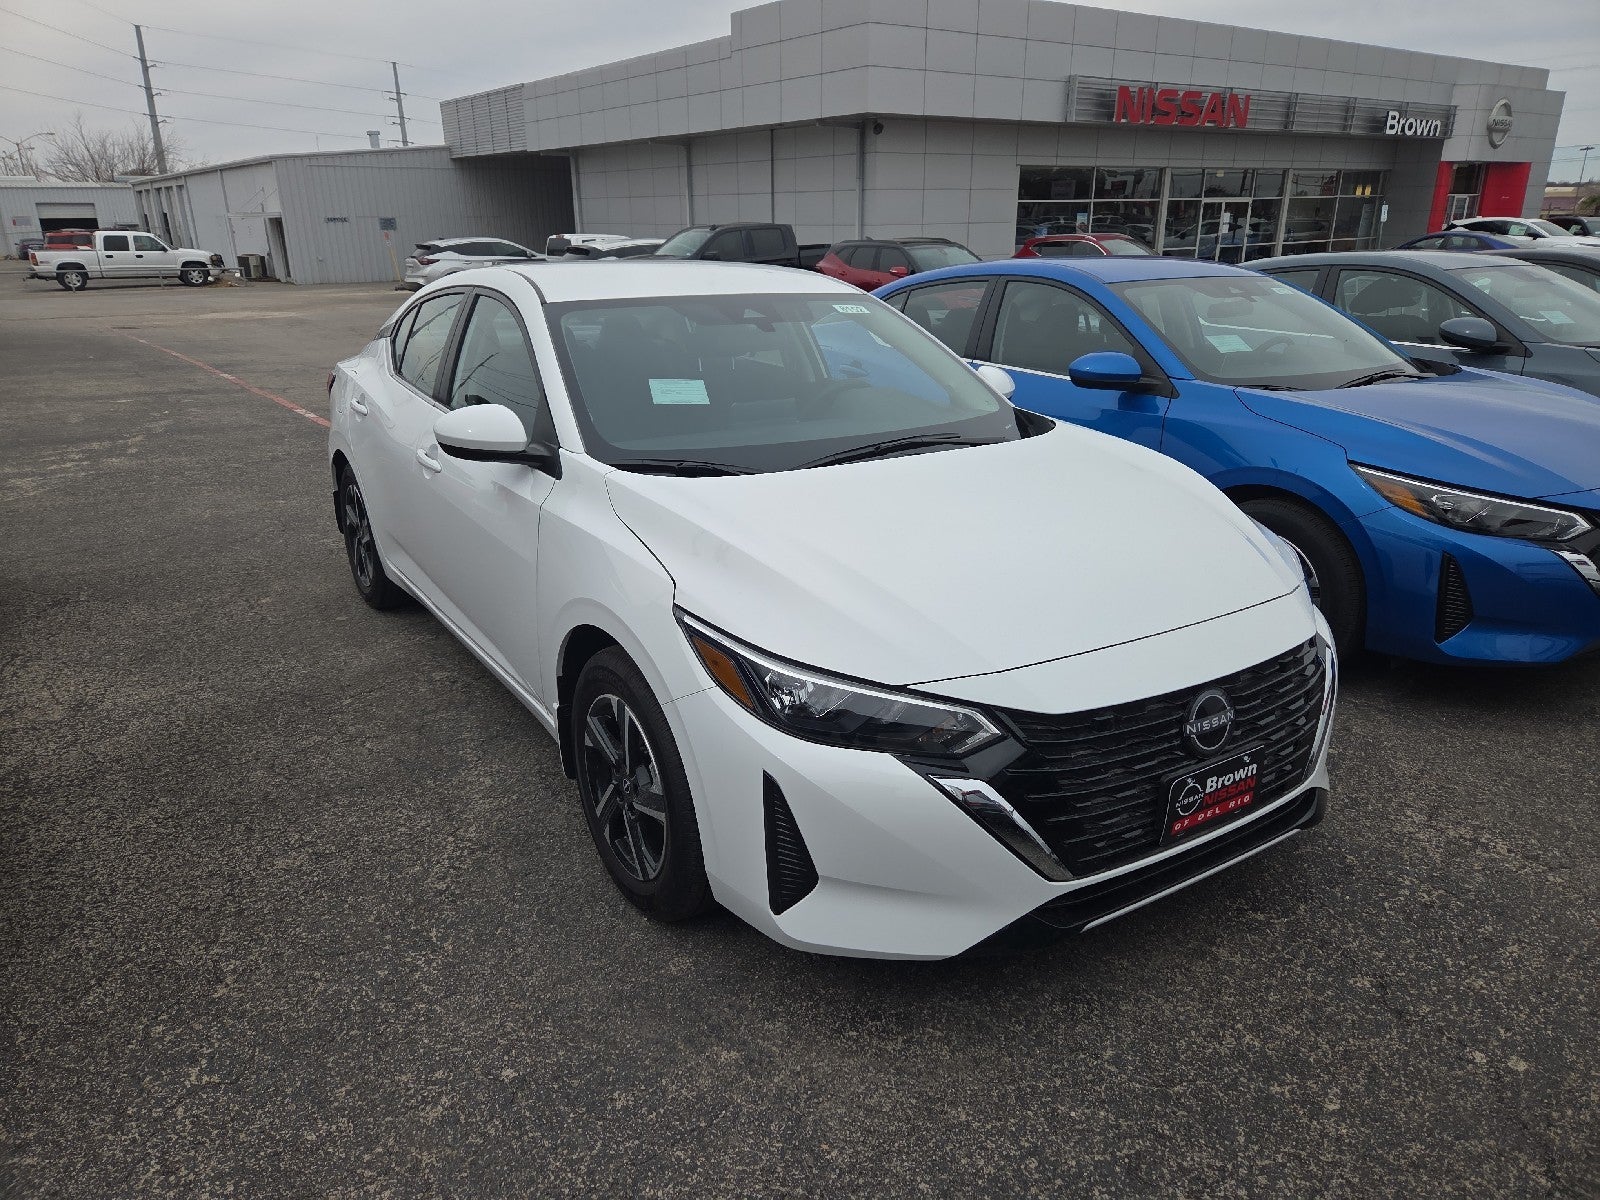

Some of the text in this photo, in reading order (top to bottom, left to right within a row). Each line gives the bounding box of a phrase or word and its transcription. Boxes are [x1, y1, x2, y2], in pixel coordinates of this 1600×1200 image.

[1113, 85, 1251, 129] NISSAN
[1385, 110, 1442, 137] Brown
[1186, 709, 1235, 735] NISSAN
[1202, 775, 1257, 807] NISSAN
[1205, 763, 1258, 794] Brown
[1174, 795, 1250, 831] OF DEL RIO
[1175, 792, 1204, 808] NISSAN
